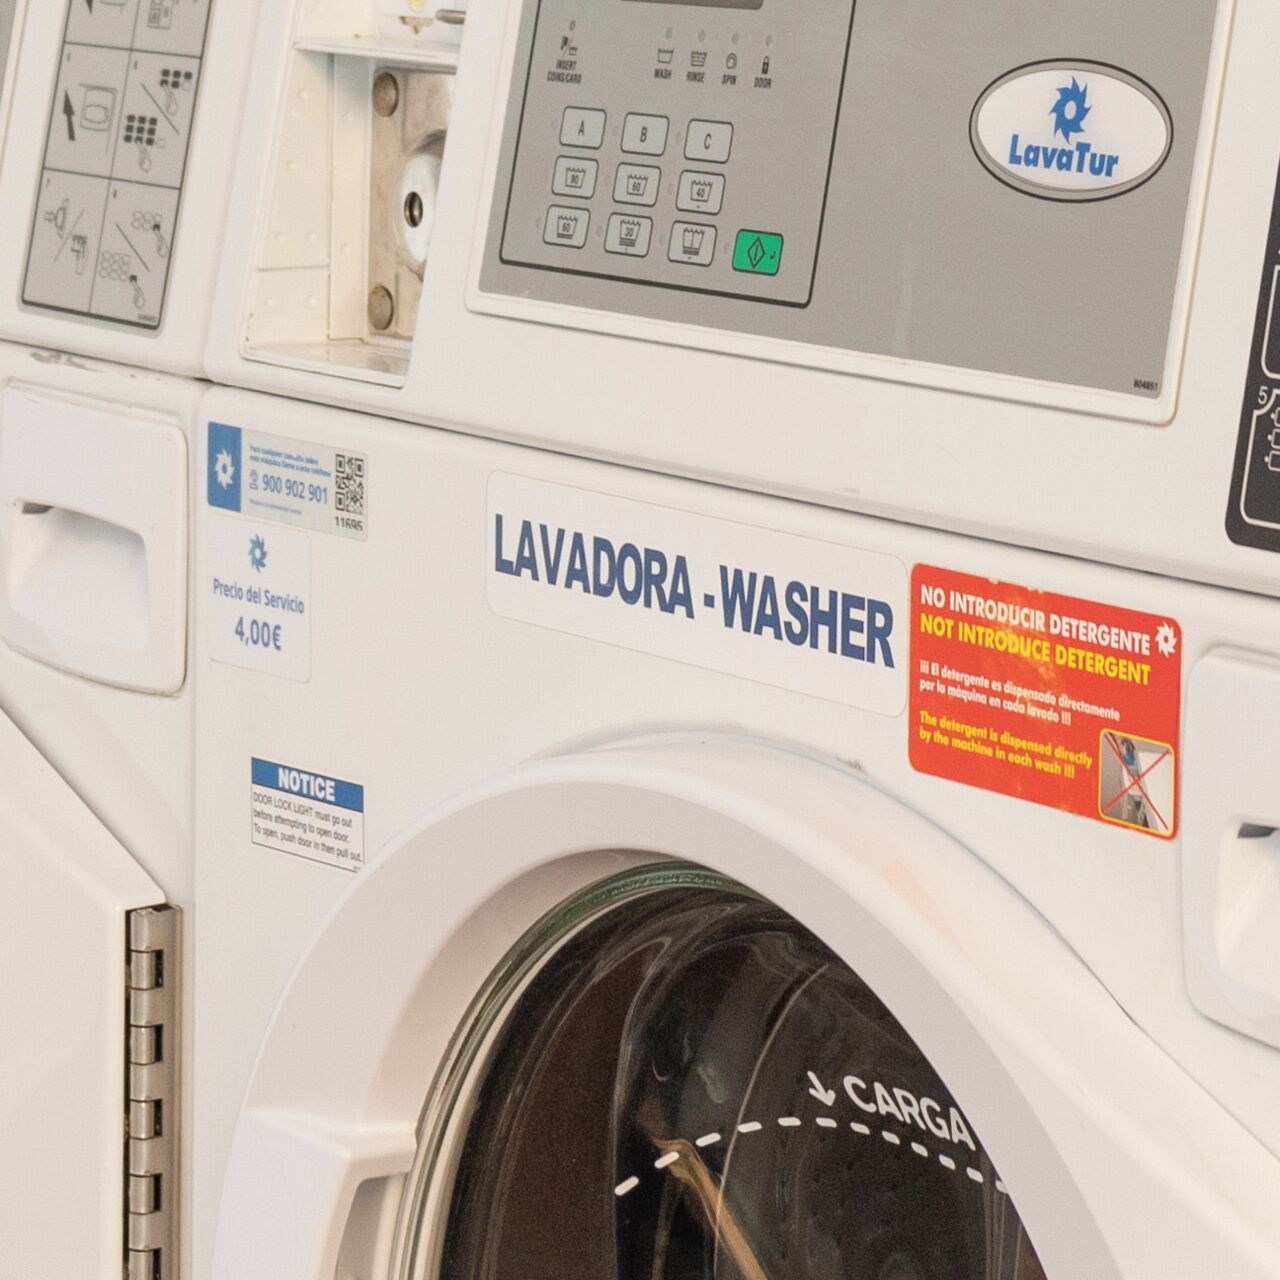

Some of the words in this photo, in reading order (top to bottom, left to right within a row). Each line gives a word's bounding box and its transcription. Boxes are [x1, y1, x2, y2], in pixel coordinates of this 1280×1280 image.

[556, 60, 577, 70] INSERT
[654, 68, 671, 80] WASH
[686, 72, 705, 83] RINSE
[722, 74, 737, 85] SPIN
[754, 77, 772, 88] DOOR
[578, 121, 585, 137] A
[640, 126, 648, 143] B
[704, 133, 712, 150] C
[1008, 134, 1119, 177] LavaTur
[570, 175, 580, 185] 90
[632, 182, 641, 192] 60
[696, 187, 706, 198] 40
[562, 223, 571, 232] 60
[624, 227, 634, 238] 30
[1257, 386, 1268, 405] 5
[262, 474, 282, 494] 900
[285, 478, 305, 500] 902
[308, 484, 328, 504] 901
[213, 578, 243, 601] Precio
[246, 586, 261, 604] del
[264, 589, 304, 614] Servicio
[495, 514, 695, 619] LAVADORA
[719, 565, 895, 669] WASHER
[921, 584, 945, 608] NO
[950, 591, 1045, 632] INTRODUCIR
[1049, 613, 1150, 655] DETERGENTE
[235, 616, 282, 651] 4,00€
[921, 613, 954, 639] NOT
[958, 621, 1050, 662] INTRODUCE
[1055, 644, 1151, 686] DETERGENT
[920, 680, 935, 693] por
[937, 681, 946, 694] la
[948, 684, 987, 705] máquina
[990, 695, 1001, 707] en
[1003, 698, 1024, 714] cada
[1027, 702, 1059, 723] lavado
[1061, 710, 1072, 725] !!!
[931, 662, 939, 676] El
[941, 666, 990, 689] detergente
[991, 680, 1001, 691] es
[1004, 678, 1056, 705] dispensado
[1059, 691, 1120, 722] directamente
[920, 710, 937, 727] The
[939, 715, 988, 740] detergent
[990, 726, 998, 741] is
[1000, 730, 1052, 756] dispensed
[1055, 746, 1093, 770] directly
[920, 728, 931, 744] by
[934, 731, 949, 746] the
[951, 734, 993, 758] machine
[996, 747, 1005, 760] in
[1008, 749, 1032, 767] each
[1035, 756, 1061, 774] wash
[1063, 764, 1075, 779] !!!
[278, 767, 335, 802] NOTICE
[254, 792, 272, 805] DOOR
[274, 799, 292, 811] LOCK
[294, 802, 313, 816] LIGHT
[332, 815, 340, 826] go
[254, 822, 261, 834] To
[298, 837, 312, 847] door
[308, 824, 314, 833] to
[316, 827, 332, 837] open
[842, 1074, 977, 1151] CARGA
